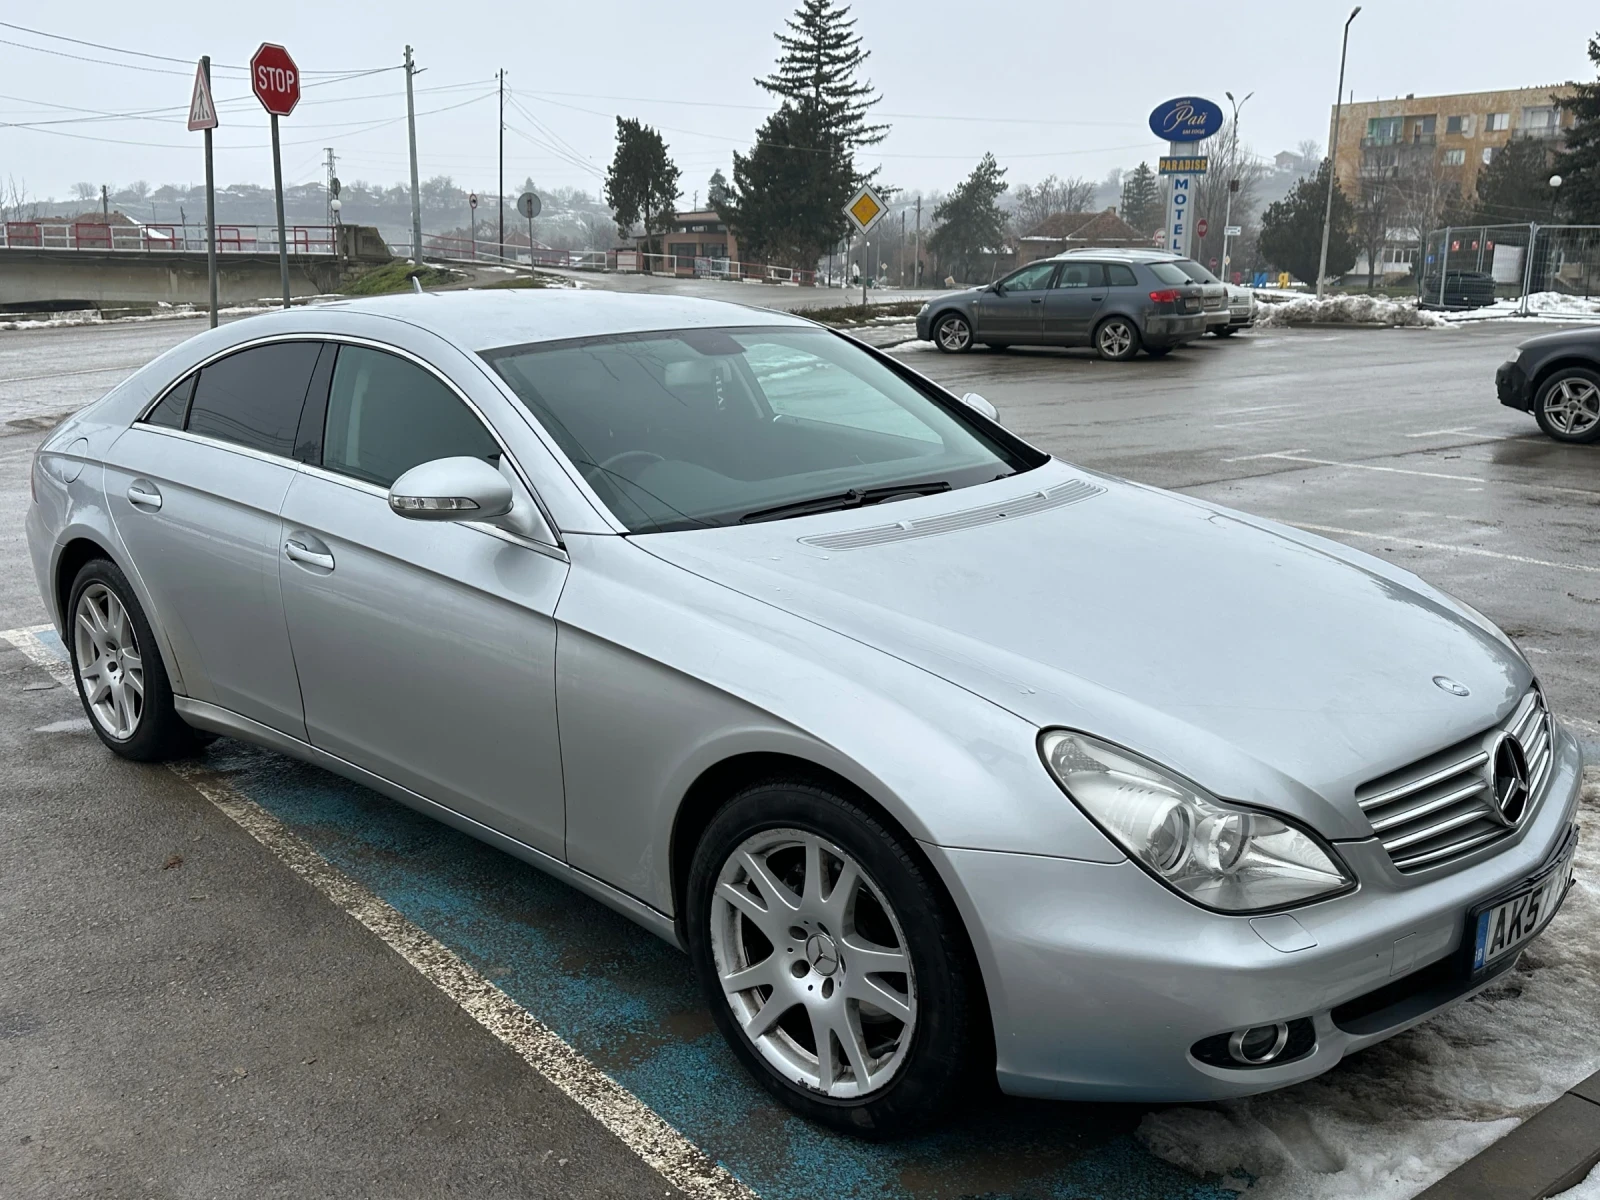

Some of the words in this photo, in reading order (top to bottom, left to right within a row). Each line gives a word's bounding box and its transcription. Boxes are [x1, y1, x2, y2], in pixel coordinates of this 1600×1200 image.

[258, 65, 294, 93] STOP
[1163, 105, 1208, 132] Рай
[1159, 159, 1207, 171] PARADISE
[1173, 178, 1189, 250] MOTEL
